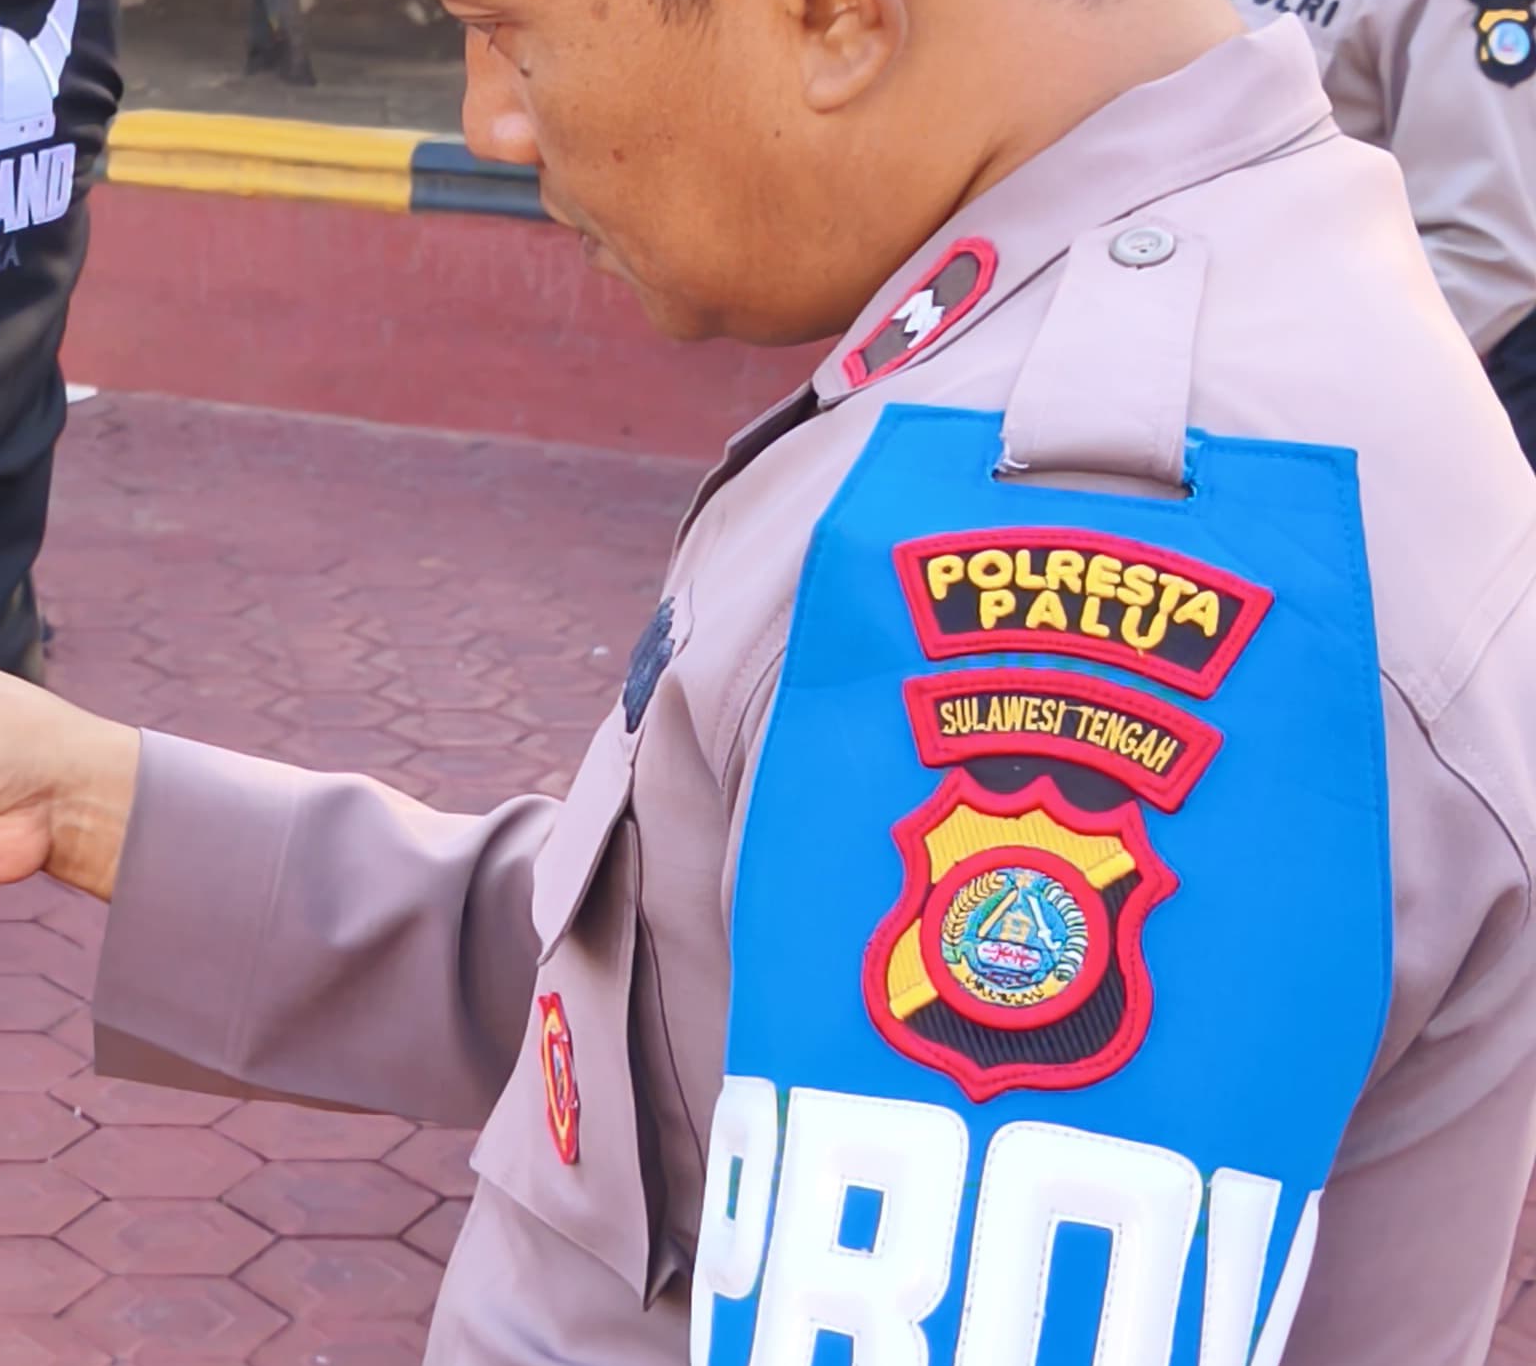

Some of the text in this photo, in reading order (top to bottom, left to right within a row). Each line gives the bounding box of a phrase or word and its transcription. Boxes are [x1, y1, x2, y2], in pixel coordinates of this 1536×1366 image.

[926, 548, 1221, 638] POLRESTA
[979, 588, 1167, 650] PALU
[939, 695, 1179, 774] SULAWESI TENGAH
